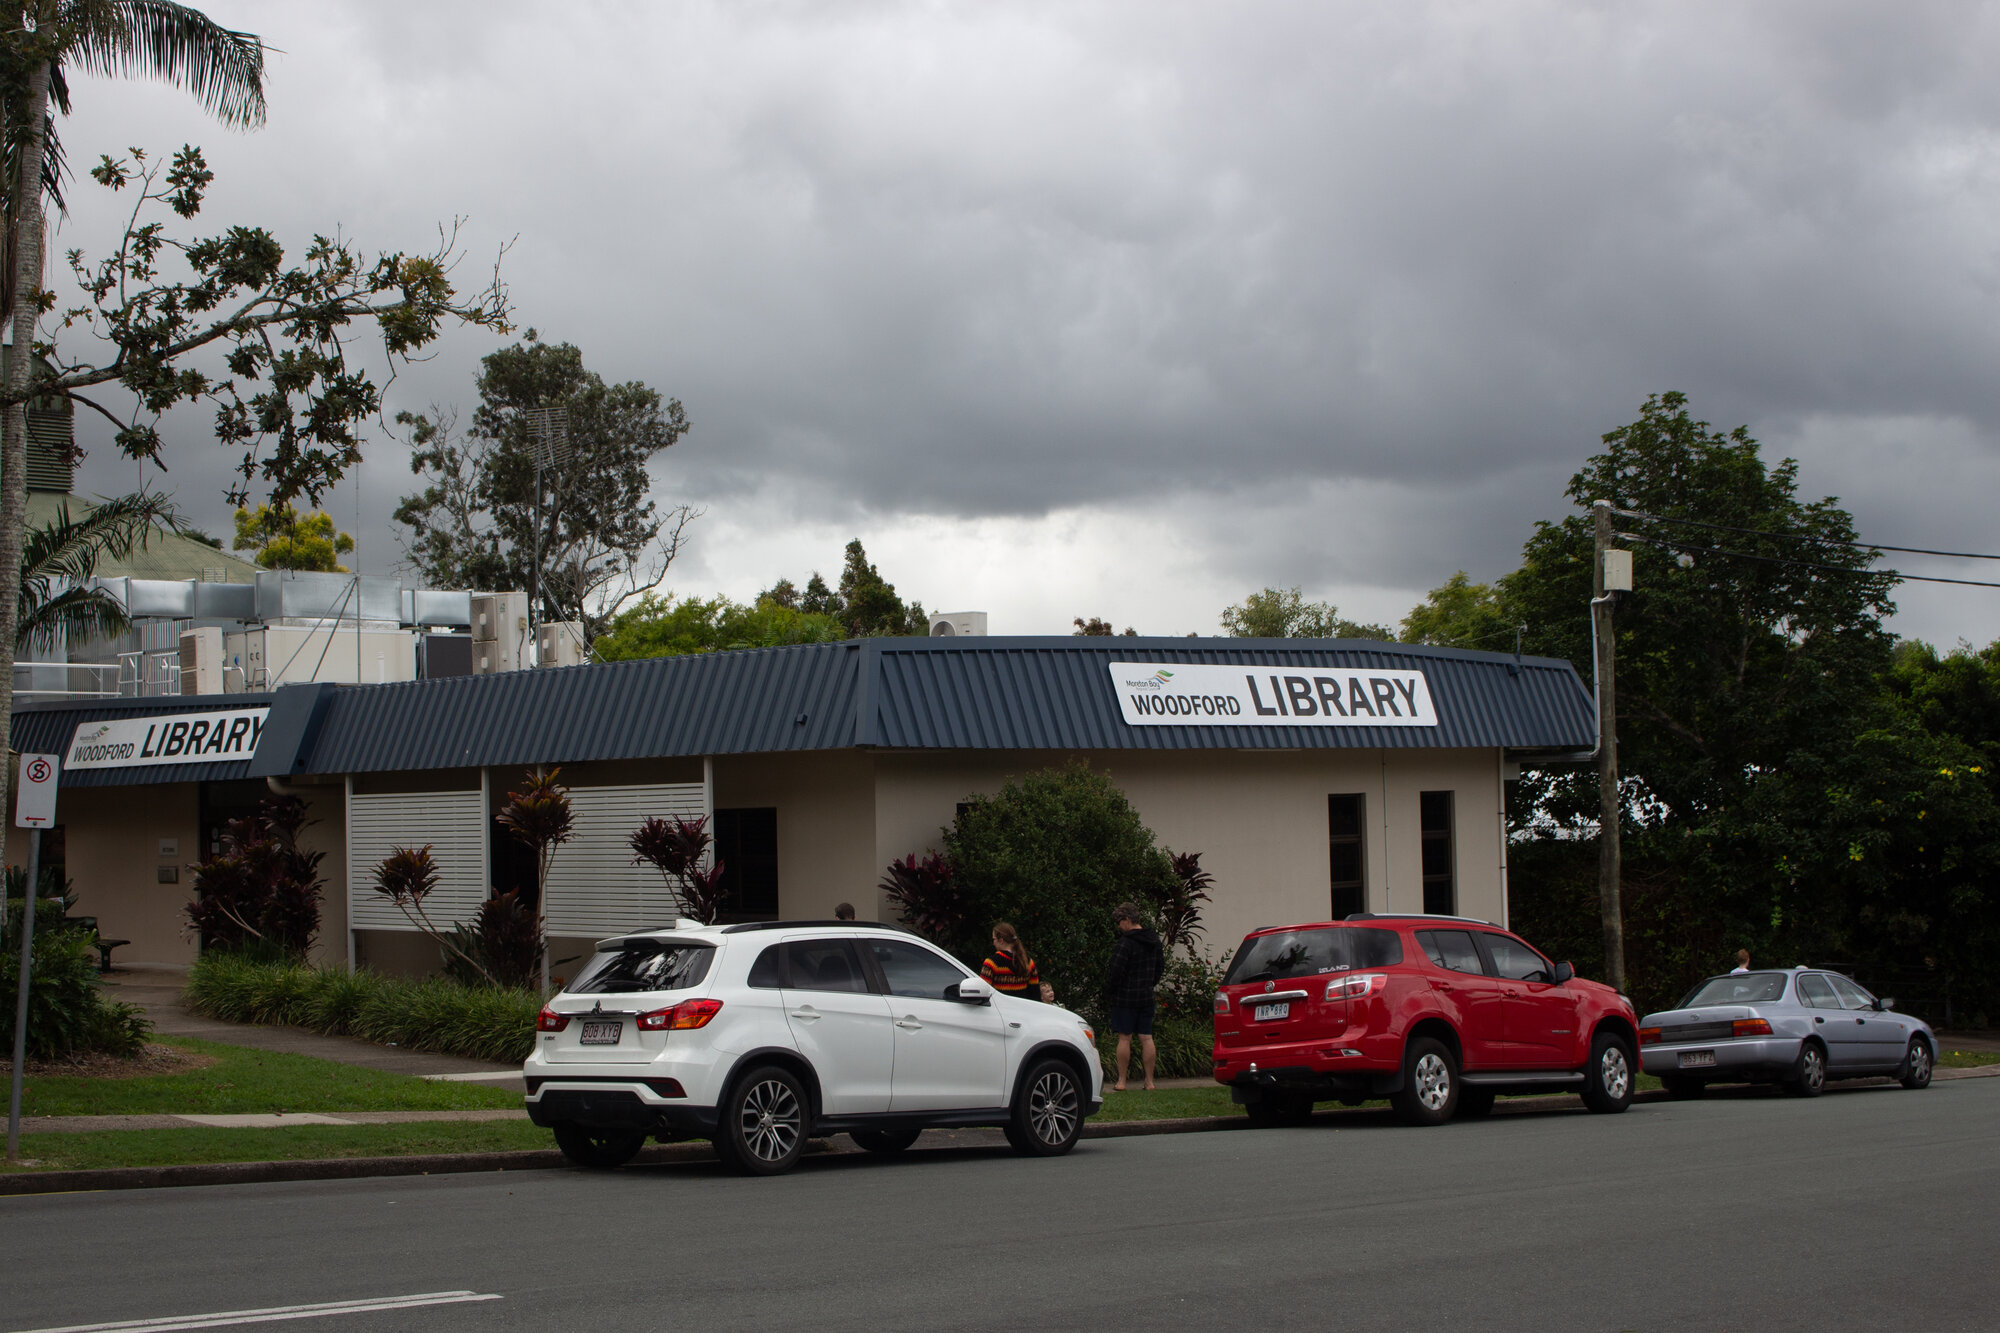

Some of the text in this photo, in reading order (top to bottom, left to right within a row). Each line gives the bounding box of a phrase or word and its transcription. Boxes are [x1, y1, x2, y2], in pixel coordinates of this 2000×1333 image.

[1125, 679, 1148, 687] Moreton
[1148, 680, 1161, 690] Bay
[1130, 675, 1418, 717] WOODFORD LIBRARY
[73, 716, 266, 762] WOODFORD LIBRARY
